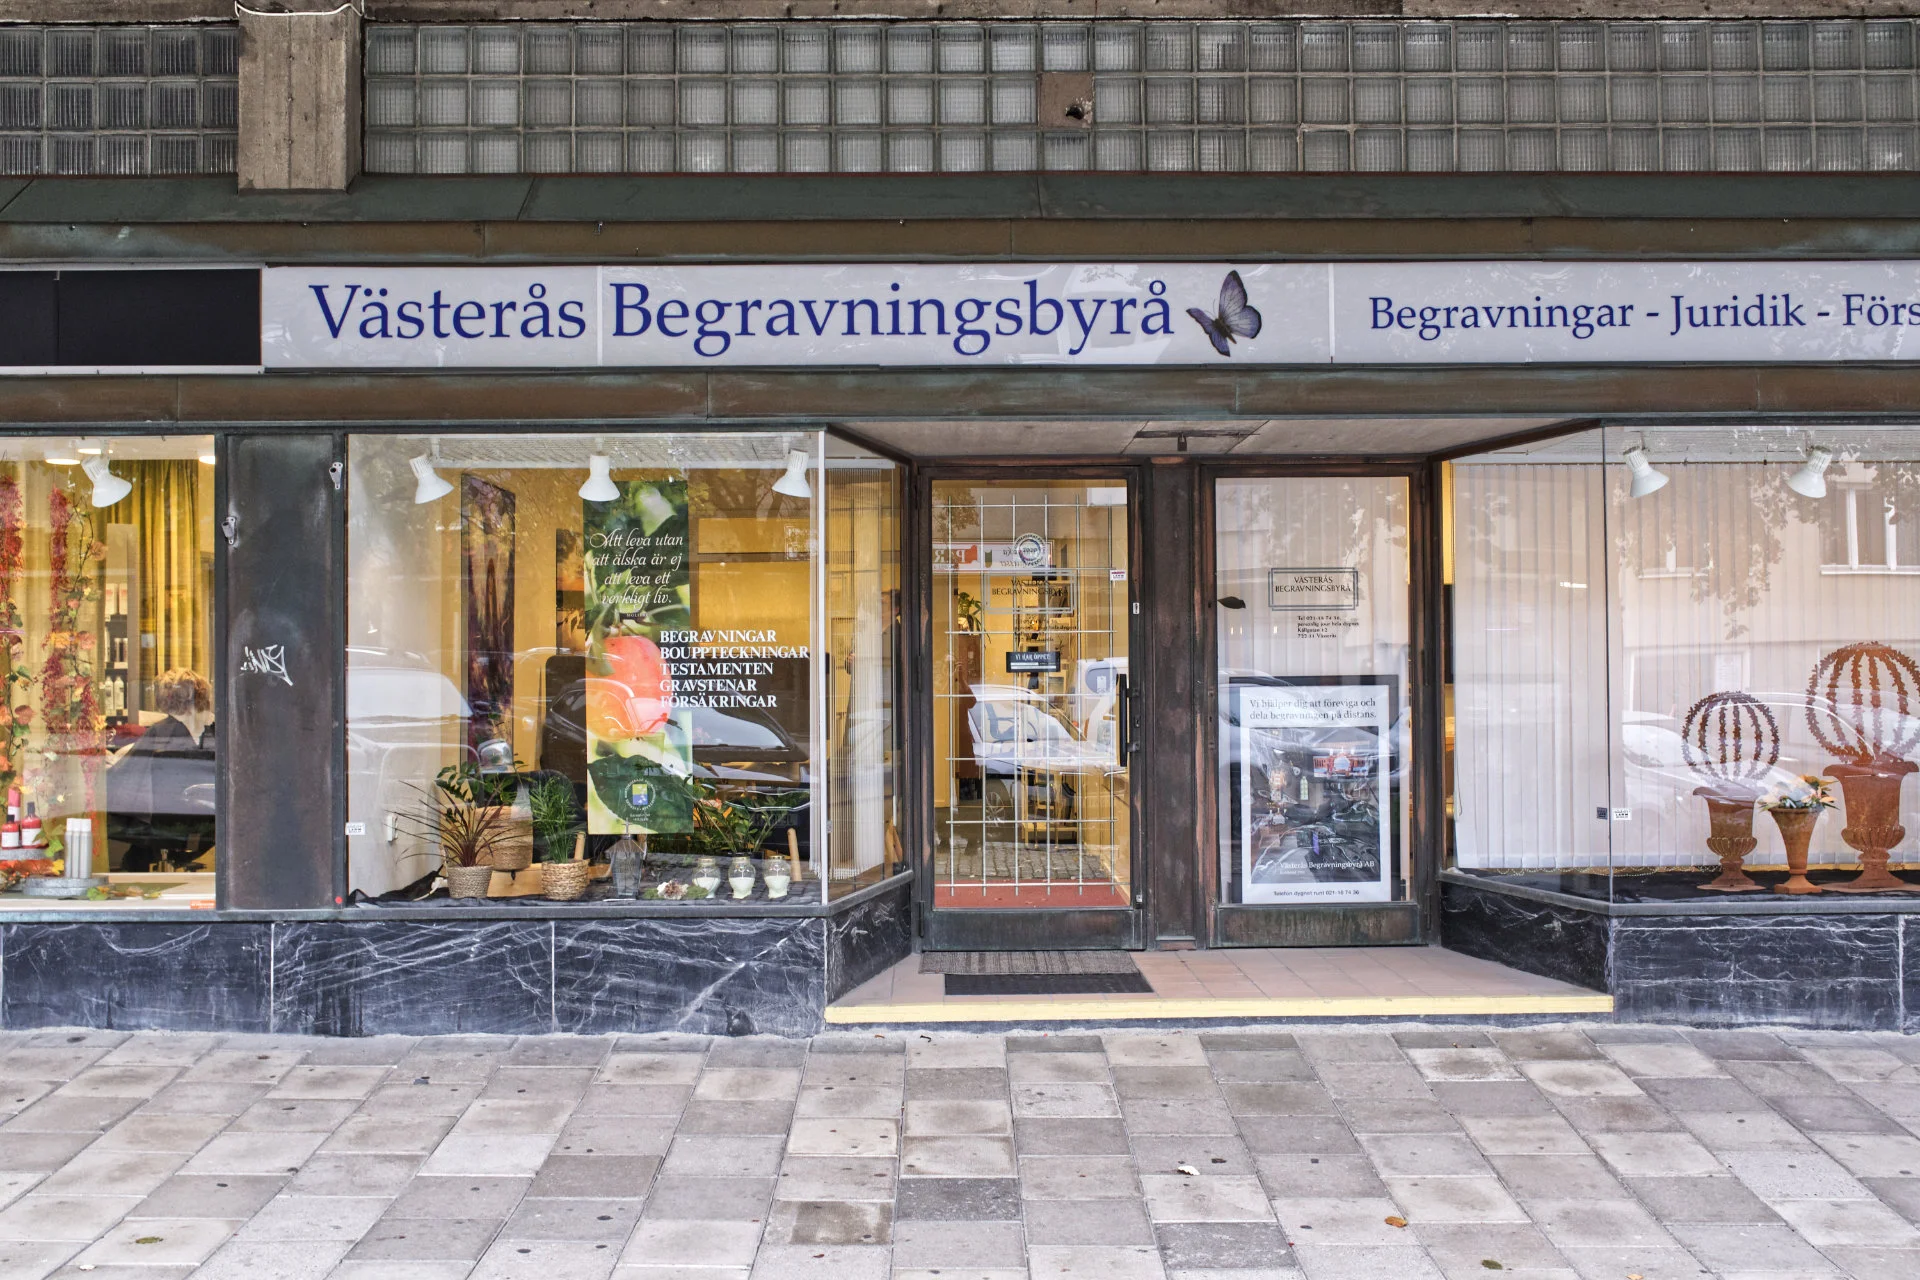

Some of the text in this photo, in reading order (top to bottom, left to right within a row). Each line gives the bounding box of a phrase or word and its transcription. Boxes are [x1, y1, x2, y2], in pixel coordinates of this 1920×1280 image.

[308, 279, 1175, 357] Västerås Begravningsbyrå
[1369, 295, 1634, 341] Begravningar
[1670, 293, 1806, 336] Juridik
[1842, 293, 1920, 327] Förs
[590, 528, 683, 549] Att leva utan
[593, 547, 682, 571] att älska är ej
[604, 566, 671, 585] att leva ett
[1293, 575, 1333, 583] VÄSTERÅS
[1275, 583, 1351, 592] BEGRAVNINGSBYRÅ
[602, 585, 672, 611] verkligt liv.
[659, 630, 776, 643] BEGRAVNINGAR
[660, 646, 809, 659] BOUPPTECKNINGAR
[659, 662, 773, 675] TESTAMENTEN
[659, 678, 757, 692] GRAVSTENAR
[660, 693, 777, 708] FÖRSÄKRINGAR
[1249, 697, 1376, 709] Vi hjälper dig att föreviga och
[1249, 709, 1377, 721] dela begravningen på distans.
[1308, 860, 1362, 870] Begravningsbyrå
